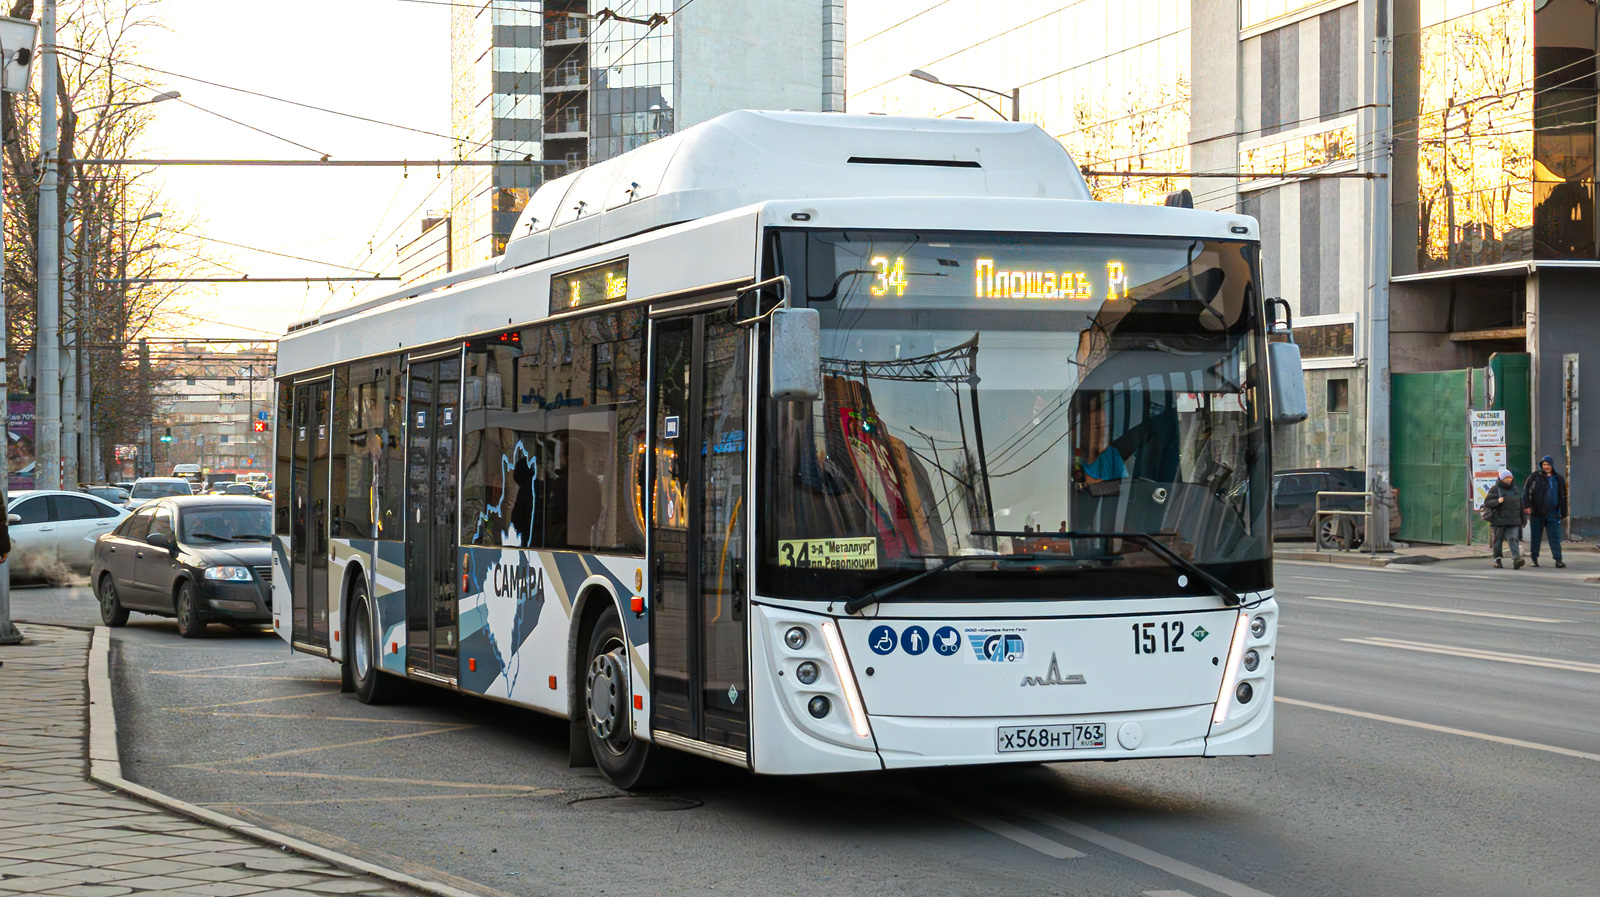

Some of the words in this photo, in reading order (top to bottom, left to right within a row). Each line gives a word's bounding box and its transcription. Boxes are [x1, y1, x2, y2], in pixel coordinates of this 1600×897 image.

[870, 255, 908, 296] 34
[781, 542, 811, 568] 34
[825, 540, 875, 556] "Металлург"
[494, 563, 545, 603] САМАРА
[1132, 620, 1184, 654] 1512
[1004, 728, 1071, 749] Х568НТ
[1075, 726, 1102, 740] 763
